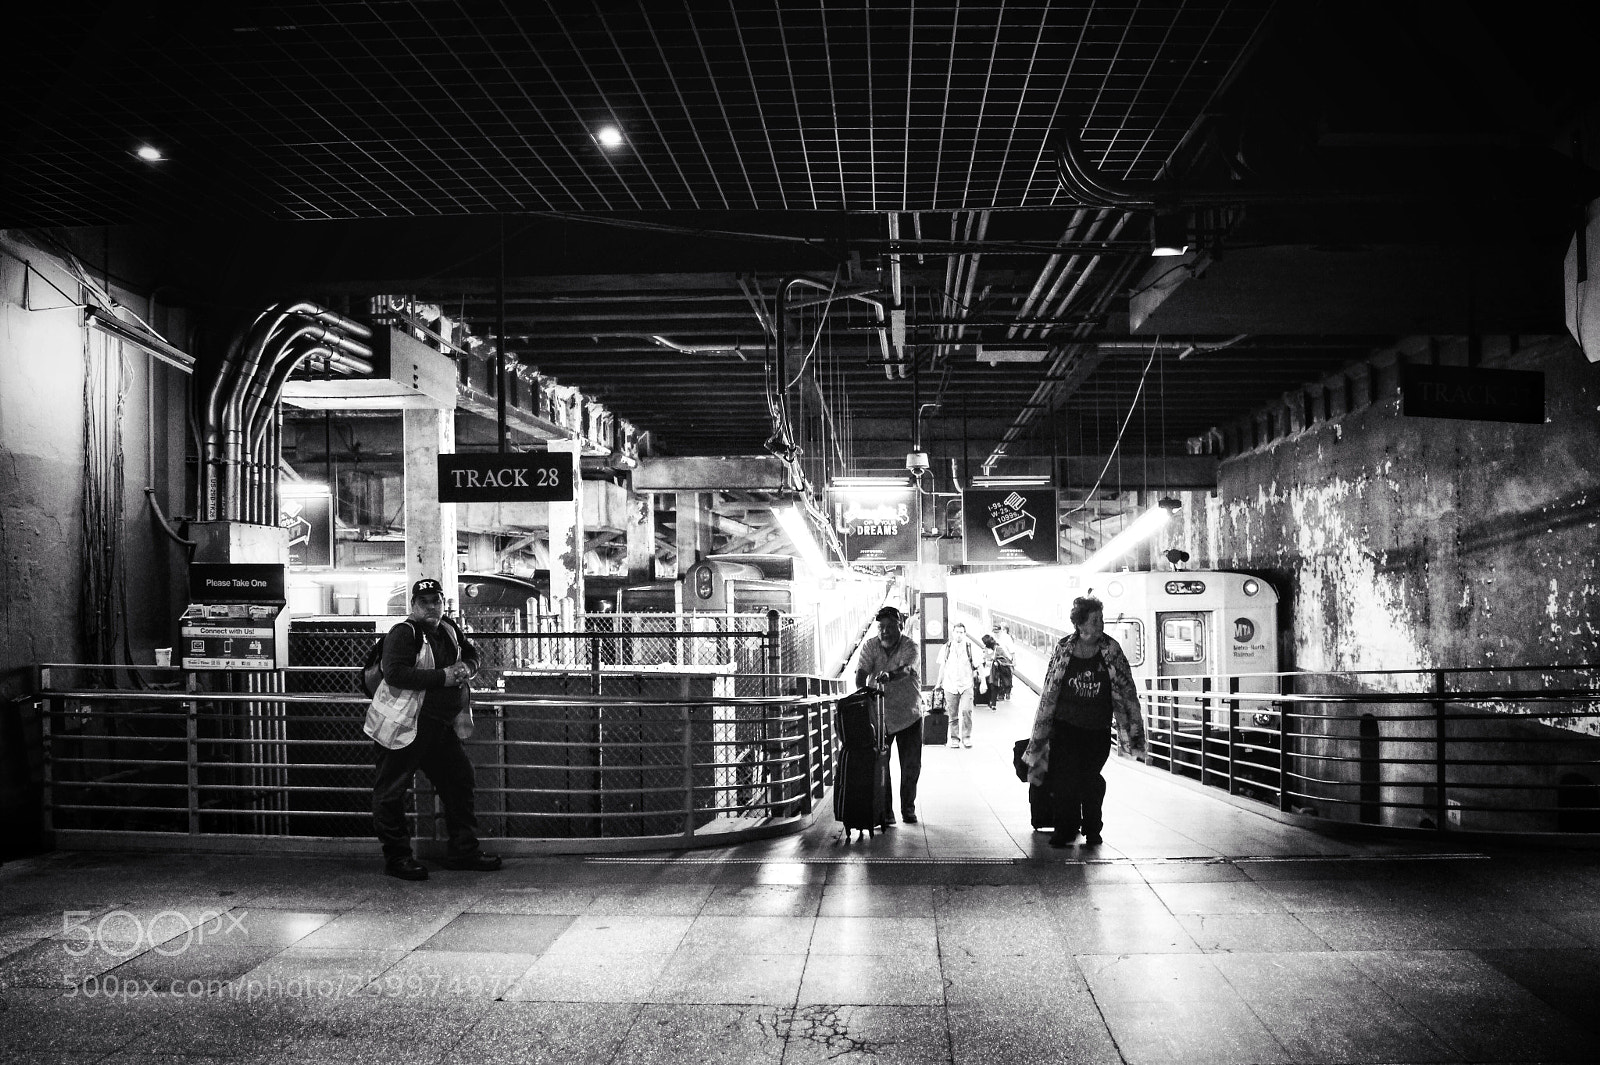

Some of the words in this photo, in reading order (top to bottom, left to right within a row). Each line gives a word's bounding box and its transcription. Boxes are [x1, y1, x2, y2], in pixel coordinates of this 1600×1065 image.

[1418, 381, 1497, 405] TRACK
[451, 468, 529, 488] TRACK
[536, 468, 560, 487] 28
[857, 525, 898, 536] DREAMS
[206, 579, 231, 587] Please
[232, 579, 250, 587] Take
[251, 579, 267, 587] One
[418, 581, 434, 590] NY
[200, 627, 227, 635] Connect
[1234, 622, 1251, 638] MTA
